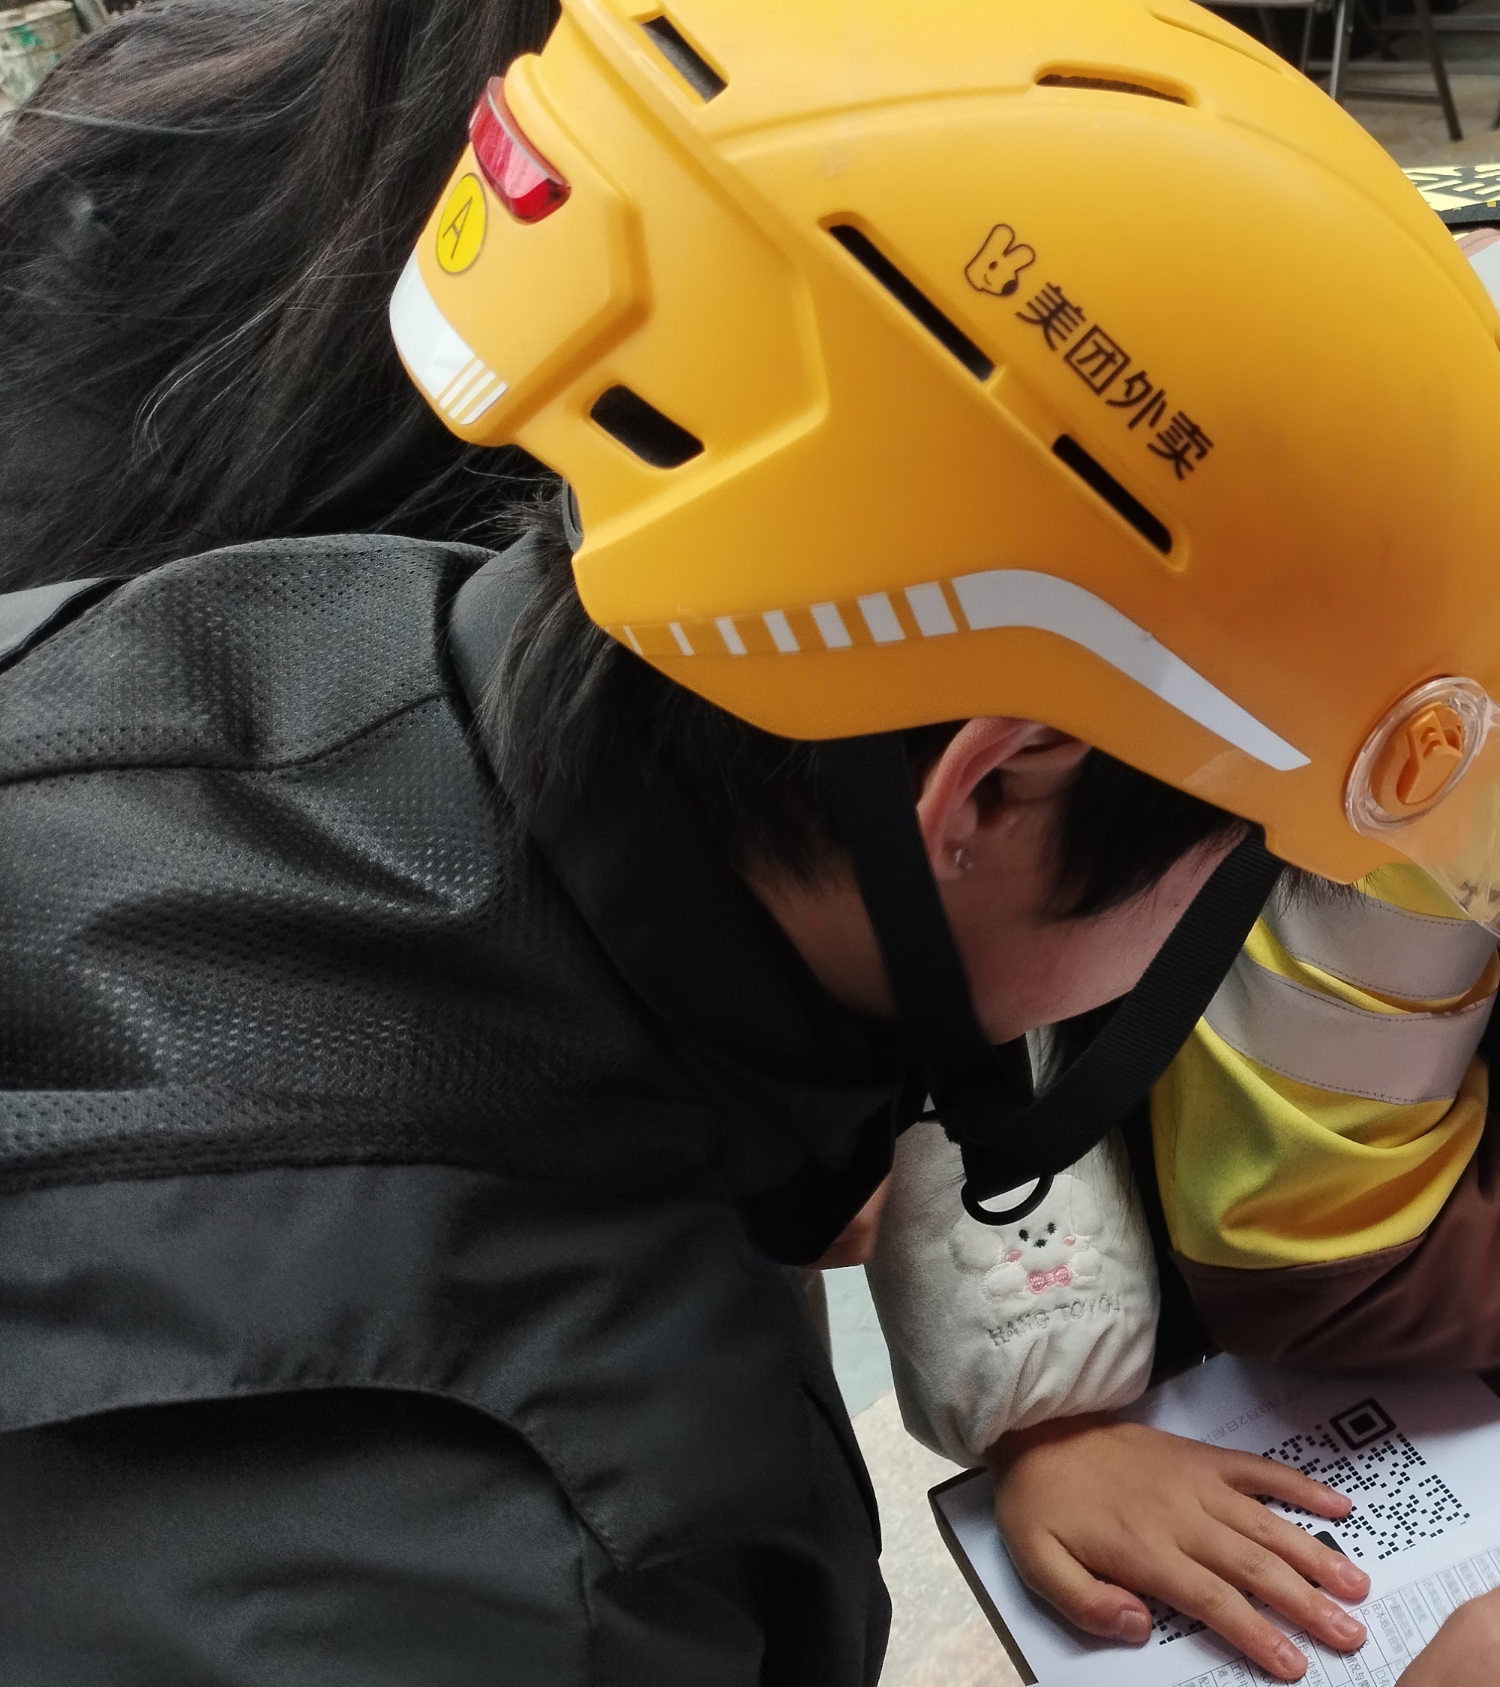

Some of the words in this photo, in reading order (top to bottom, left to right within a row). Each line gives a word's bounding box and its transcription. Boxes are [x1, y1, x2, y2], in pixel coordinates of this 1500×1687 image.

[441, 195, 473, 260] A
[1015, 281, 1214, 481] 美团外卖
